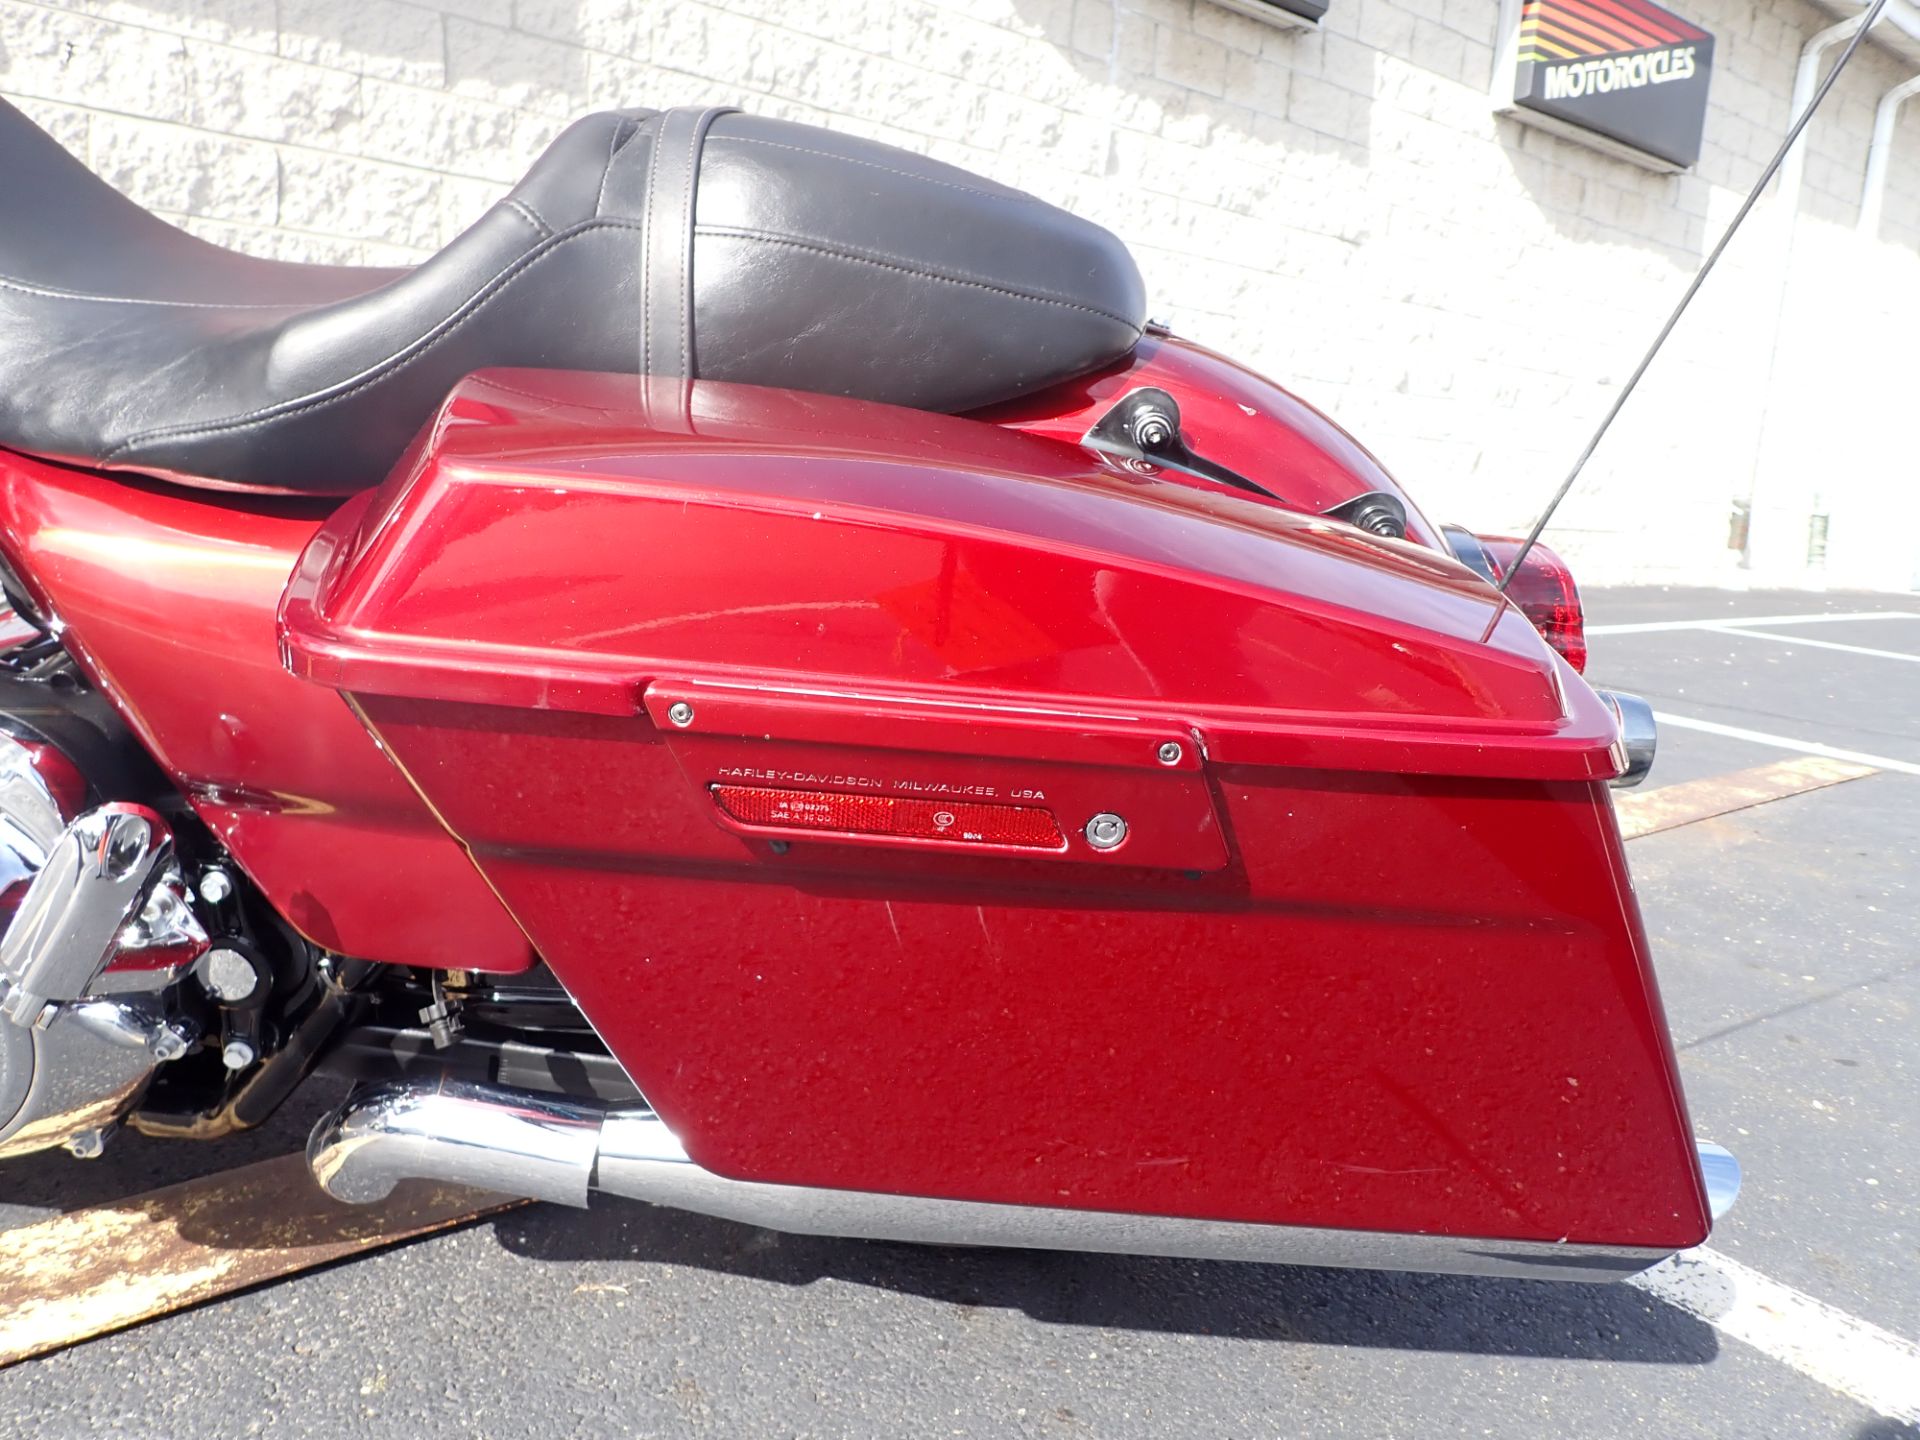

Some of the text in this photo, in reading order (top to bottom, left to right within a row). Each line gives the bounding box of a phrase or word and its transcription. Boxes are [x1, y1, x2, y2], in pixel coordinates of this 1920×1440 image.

[1544, 47, 1695, 100] MOTORCYCLES
[718, 767, 883, 788] HARLEY-DAVIDSON
[1010, 789, 1045, 800] USA
[771, 810, 790, 819] SAE
